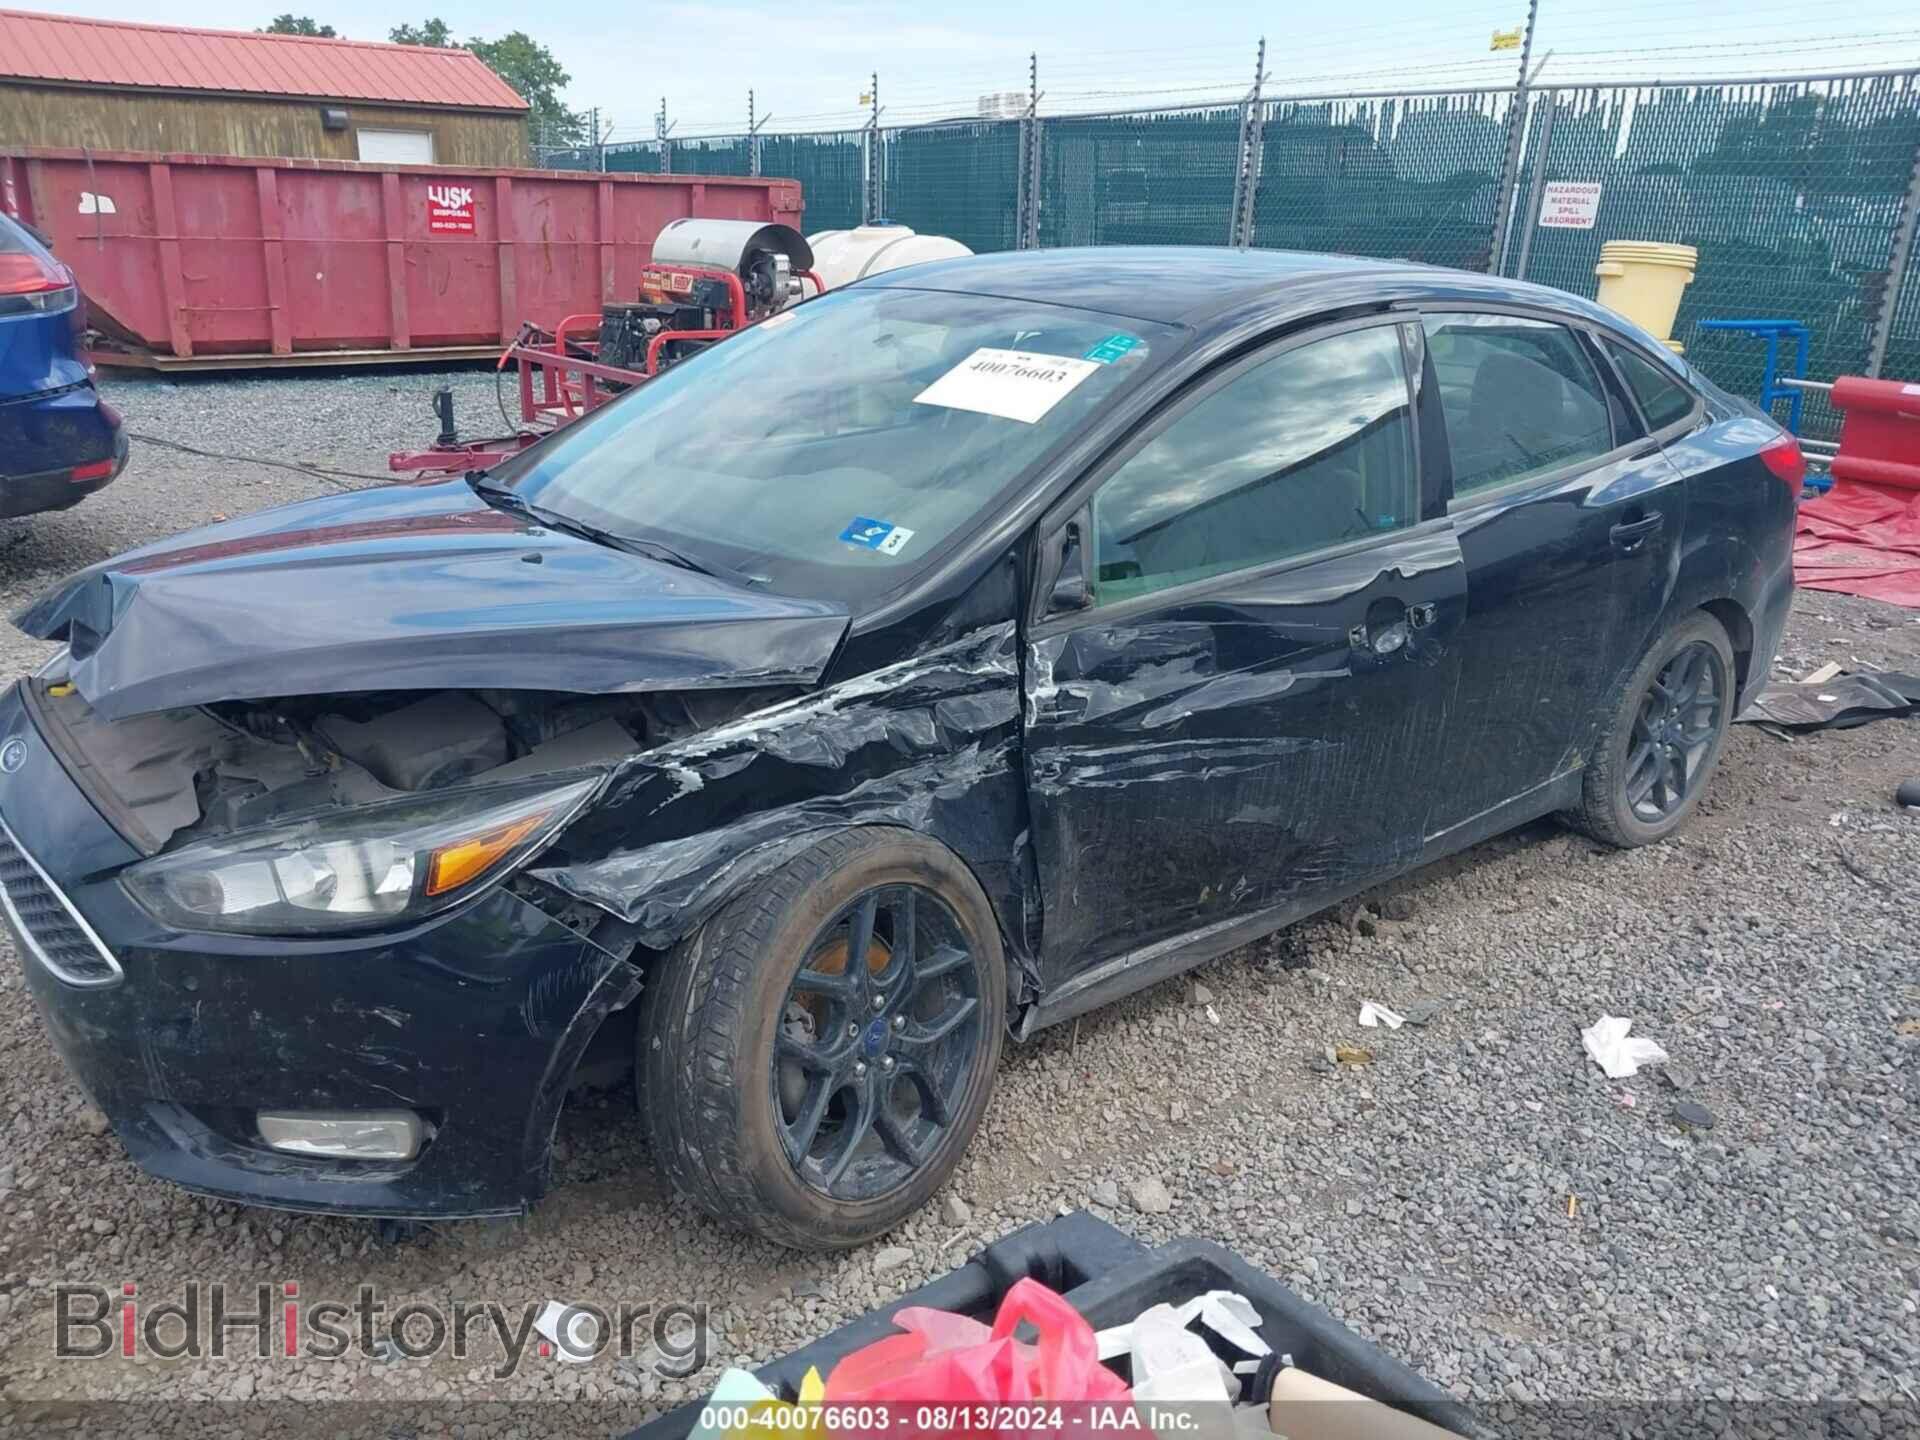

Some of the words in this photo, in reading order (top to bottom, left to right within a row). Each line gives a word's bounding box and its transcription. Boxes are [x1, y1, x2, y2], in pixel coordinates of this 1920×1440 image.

[1547, 186, 1599, 194] HAZARDOUS
[428, 185, 473, 209] LUSK
[1551, 197, 1590, 205] MATERIAL
[1542, 215, 1592, 225] ABSORBENT
